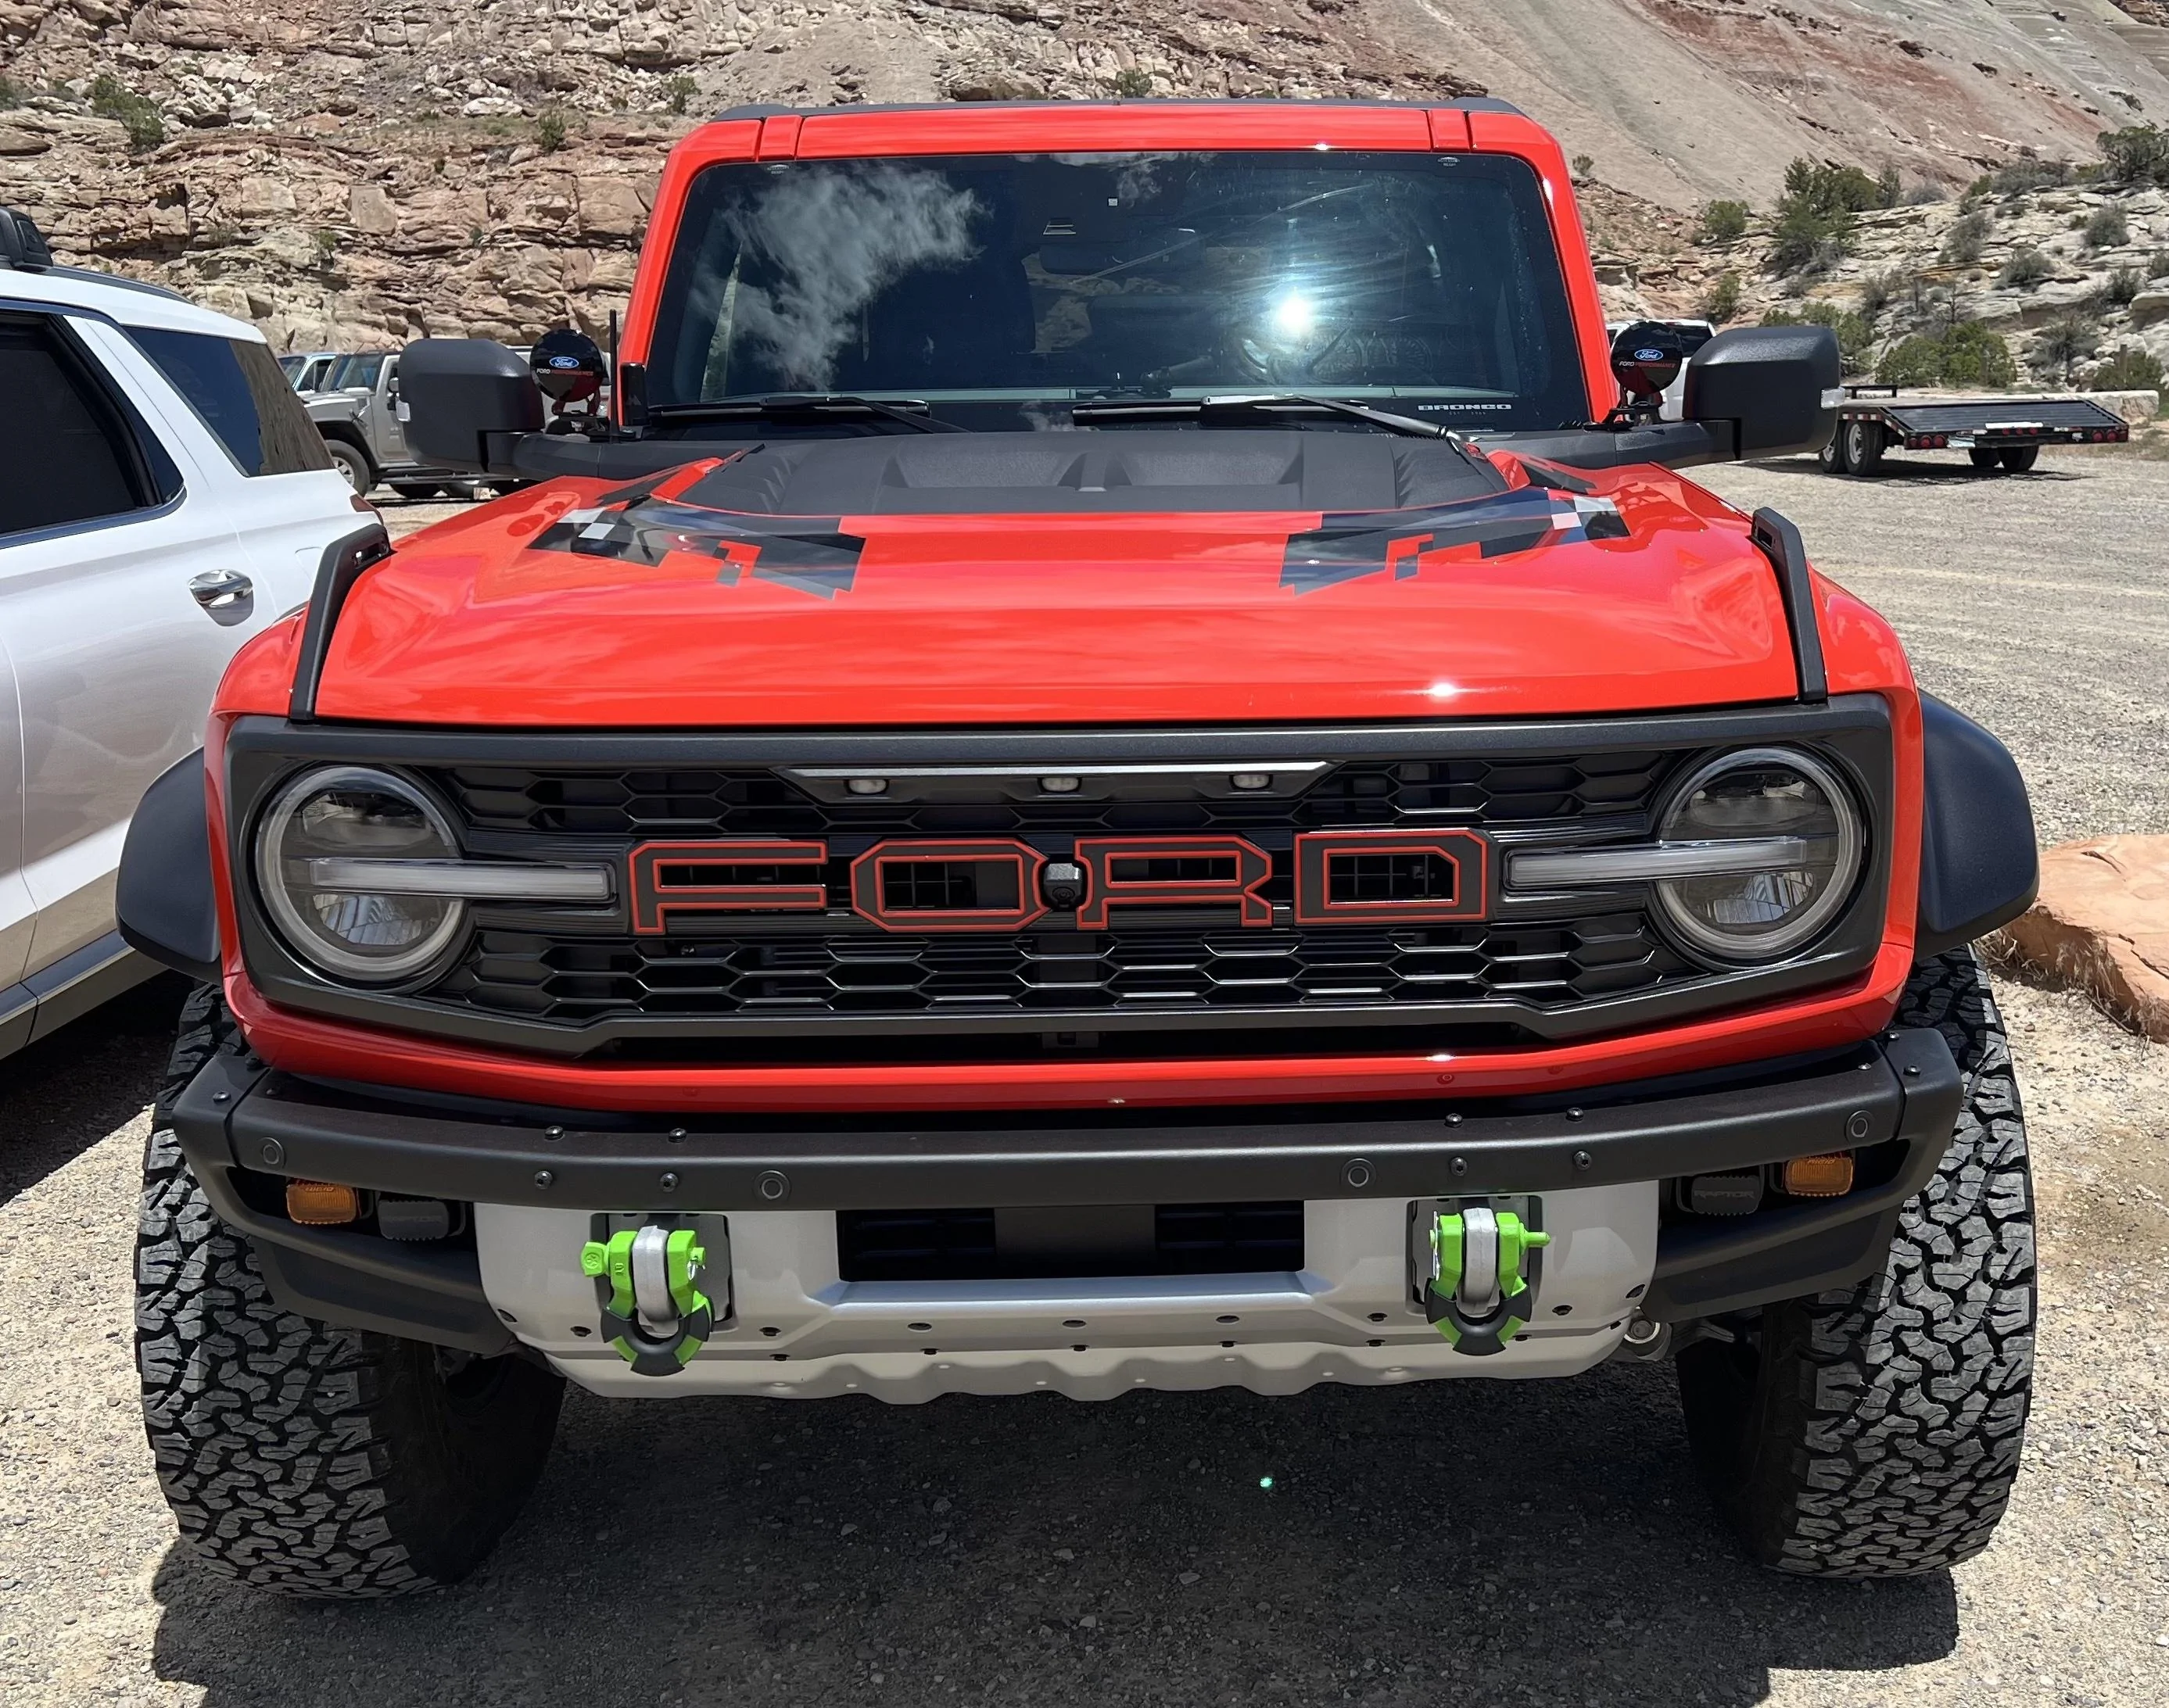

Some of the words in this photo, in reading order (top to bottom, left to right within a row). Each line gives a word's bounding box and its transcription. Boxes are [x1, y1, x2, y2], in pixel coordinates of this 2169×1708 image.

[1637, 349, 1660, 360] Ford
[554, 357, 575, 368] Ford
[629, 828, 1487, 933] FORD
[1694, 1190, 1755, 1199] RAPTOR
